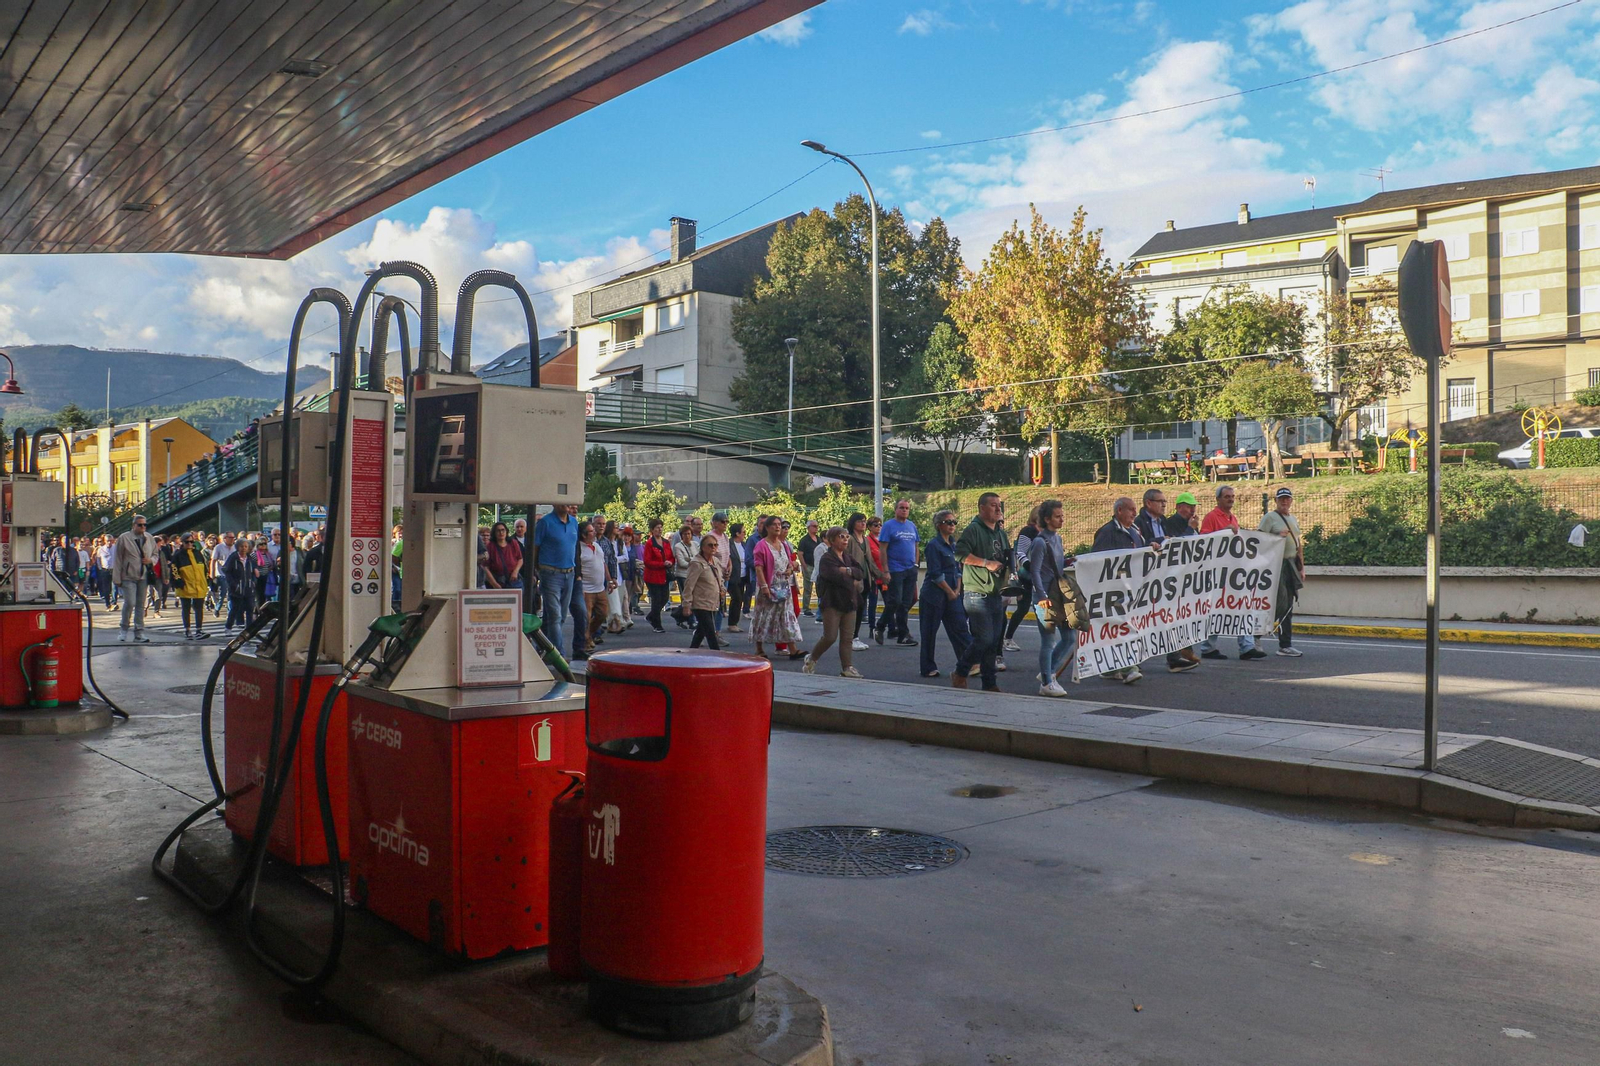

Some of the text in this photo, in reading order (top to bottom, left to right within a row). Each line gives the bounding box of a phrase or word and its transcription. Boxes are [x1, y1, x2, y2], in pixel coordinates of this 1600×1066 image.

[1099, 536, 1260, 583] NA DFENSA DOS
[1087, 564, 1273, 620] ERVIZOS PÚBLICOS
[1176, 596, 1192, 622] dos
[1191, 620, 1202, 643] DE
[236, 680, 261, 701] CEPSA
[366, 722, 402, 750] CEPSA
[368, 821, 430, 867] optima
